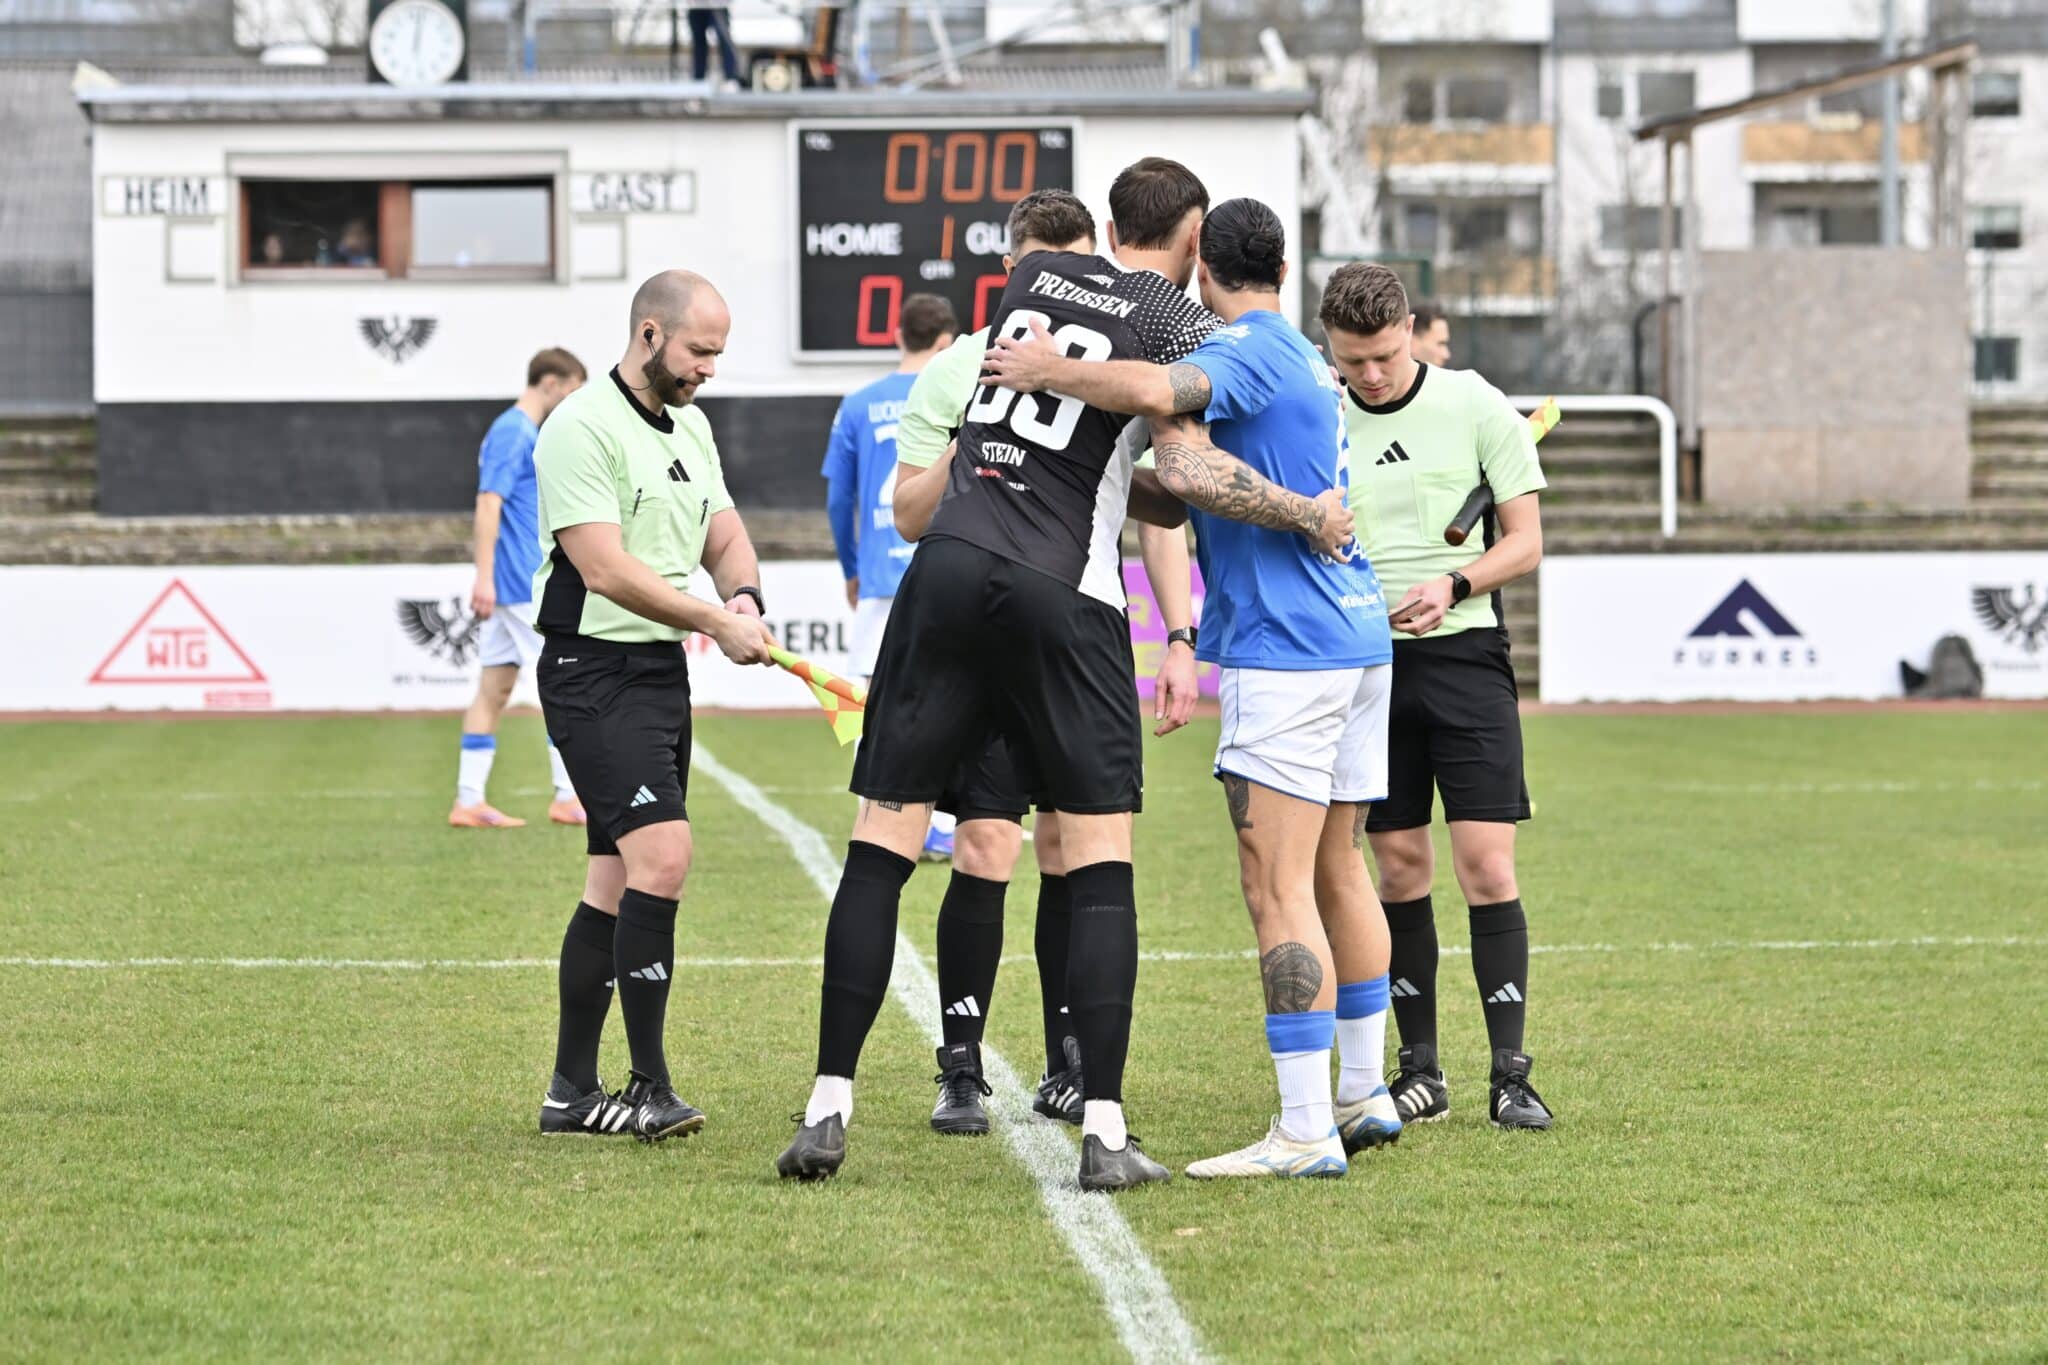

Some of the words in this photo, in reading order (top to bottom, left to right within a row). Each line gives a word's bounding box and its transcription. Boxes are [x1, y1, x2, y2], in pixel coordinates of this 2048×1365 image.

[124, 177, 208, 215] HEIM
[588, 171, 675, 212] GAST
[806, 222, 903, 256] HOME
[856, 275, 904, 346] 0
[1029, 270, 1139, 319] PREUSSEN
[982, 442, 1027, 467] STEIN
[146, 627, 208, 669] WTG
